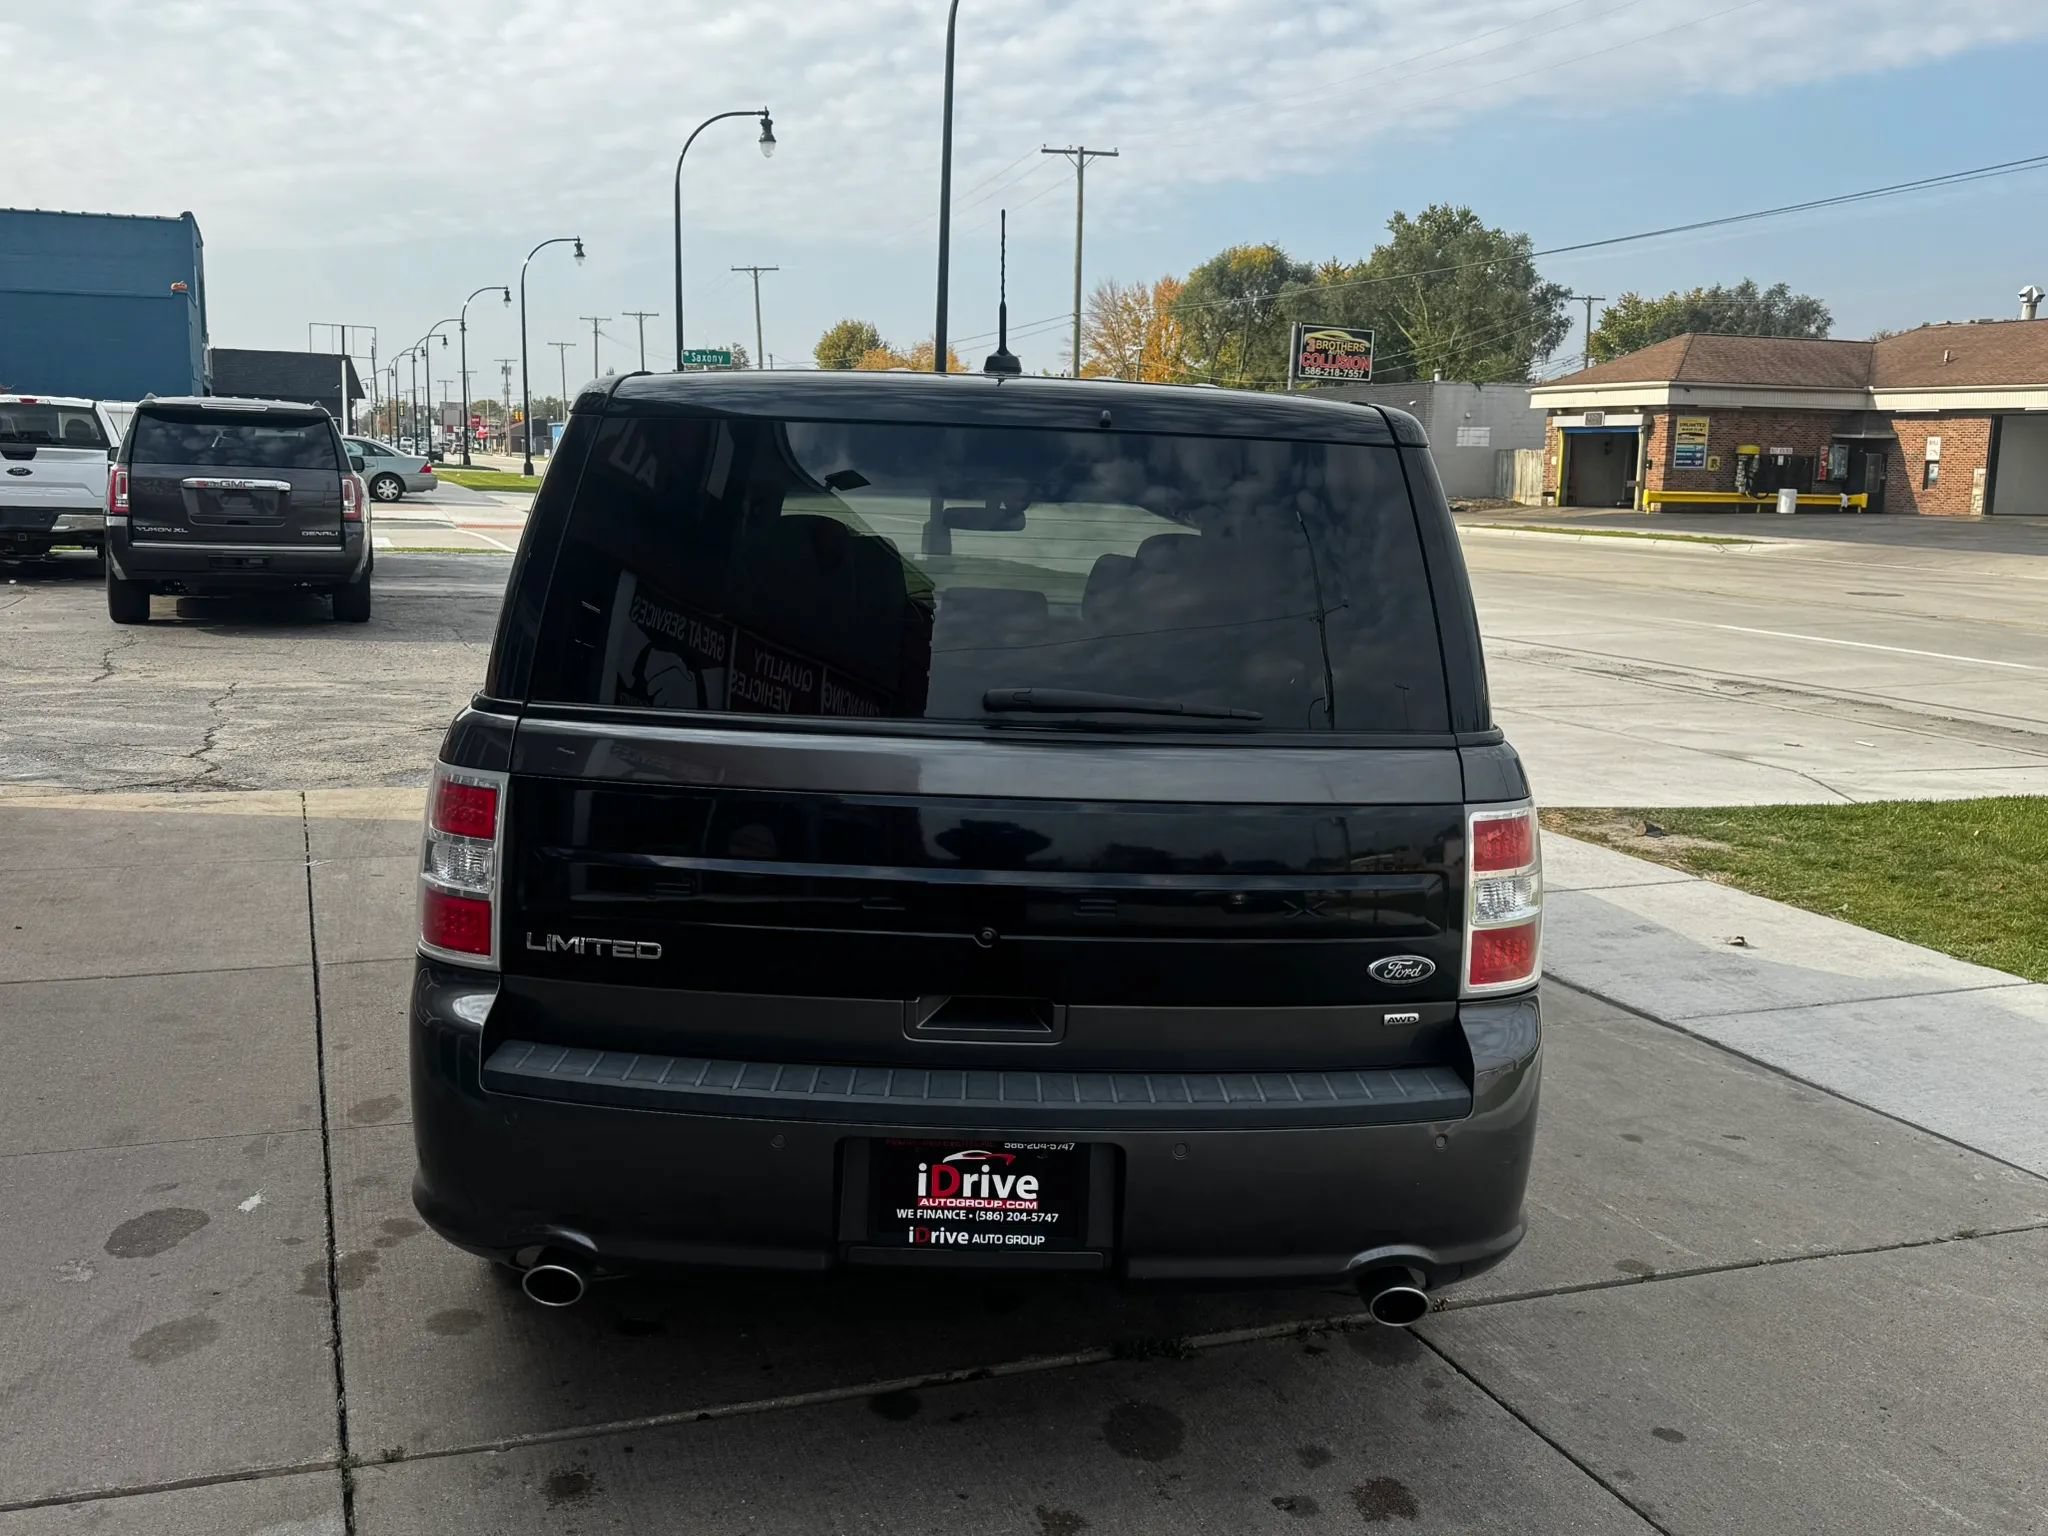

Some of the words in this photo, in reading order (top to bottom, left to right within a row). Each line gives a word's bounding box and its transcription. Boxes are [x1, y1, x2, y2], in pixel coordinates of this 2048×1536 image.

[1316, 340, 1366, 353] BROTHERS
[691, 352, 724, 363] Saxony
[1301, 352, 1372, 371] COLLISION
[1304, 366, 1364, 378] 586-218-7557
[221, 480, 254, 488] GMC
[526, 931, 663, 960] LIMITED
[1383, 960, 1422, 978] Ford
[1387, 1015, 1418, 1024] AWD
[917, 1162, 1039, 1199] iDrive
[919, 1198, 1038, 1210] AUTOGROUP.COM
[897, 1208, 914, 1219] WE
[917, 1209, 966, 1220] FINANCE
[975, 1210, 1004, 1222] (586)
[1006, 1211, 1060, 1223] 204-5747
[908, 1226, 969, 1245] iDrive
[971, 1234, 1003, 1245] AUTO
[1005, 1234, 1046, 1246] GROUP
